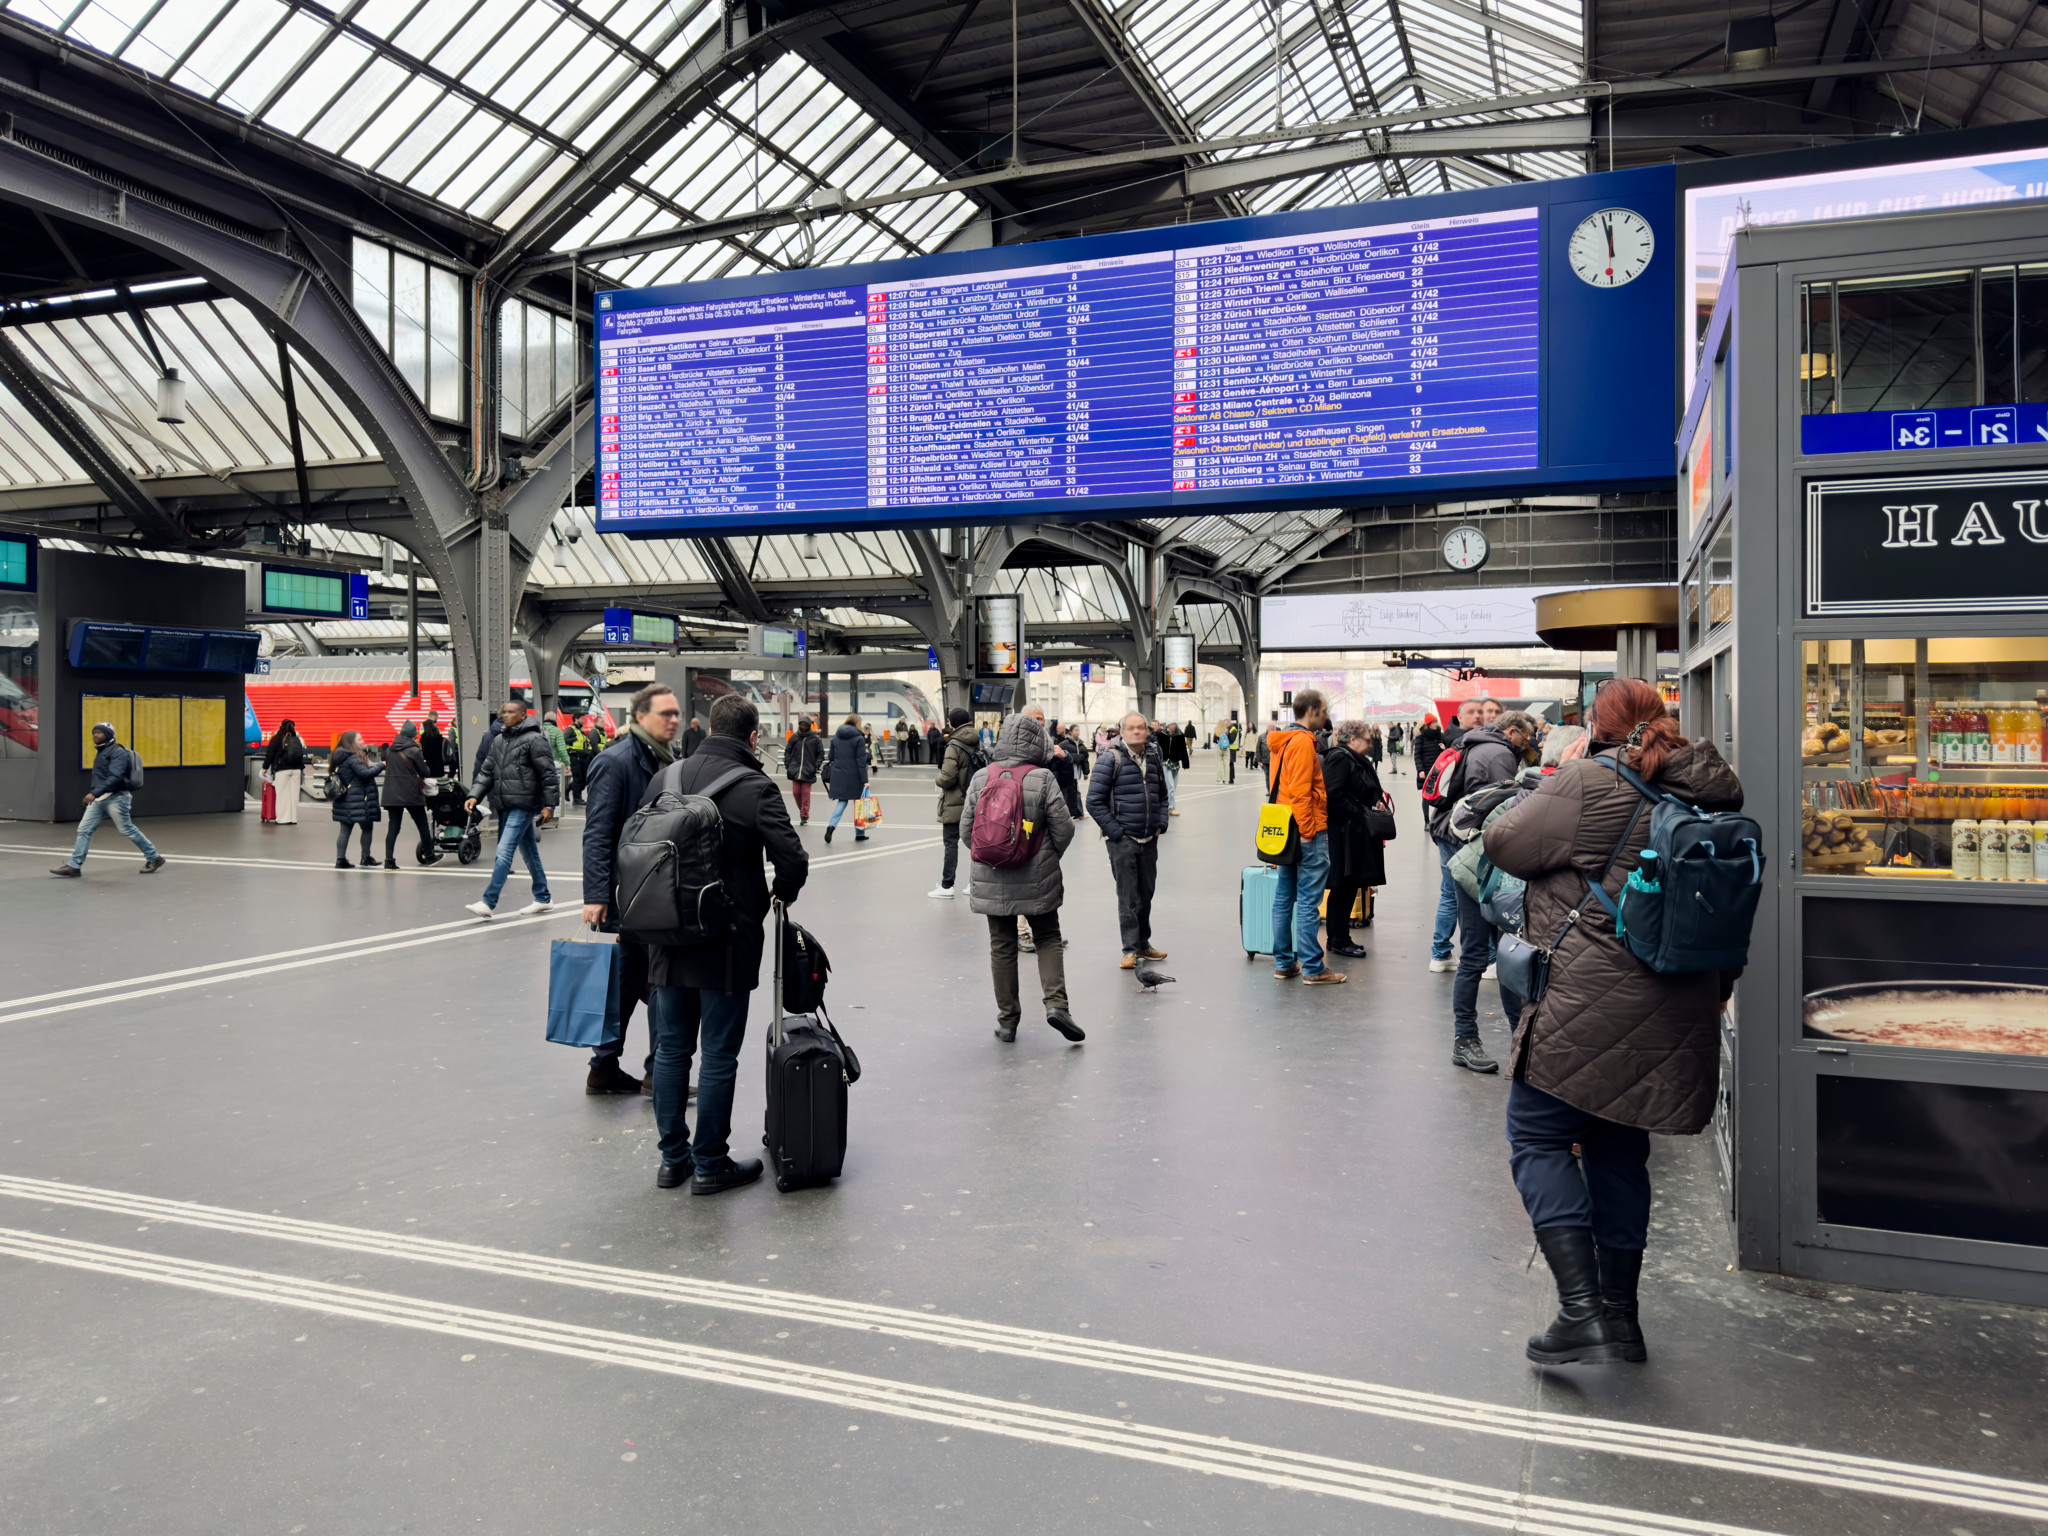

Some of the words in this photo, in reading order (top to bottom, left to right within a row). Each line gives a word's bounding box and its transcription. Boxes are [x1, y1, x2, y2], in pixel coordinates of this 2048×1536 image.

[1449, 216, 1478, 225] Hinweis
[1176, 259, 1190, 268] S24
[1200, 256, 1221, 265] 12:21
[1224, 254, 1241, 262] Zug
[1257, 248, 1293, 258] Wiedikon
[1298, 246, 1319, 254] Enge
[1323, 239, 1370, 251] Wollishofen
[1417, 232, 1423, 240] 3
[888, 291, 907, 299] 12:07
[940, 286, 968, 294] Sargans
[972, 281, 1007, 291] Landquart
[616, 310, 662, 319] Vorinformation
[664, 305, 704, 315] Bauarbeiten:
[706, 300, 759, 310] Fahrplanänderung:
[761, 297, 788, 305] Effretikon
[793, 293, 825, 302] Winterthur.
[616, 319, 635, 328] So/Mo
[714, 309, 731, 317] 05.35
[790, 301, 823, 310] Verbindung
[888, 322, 907, 330] 12:09
[936, 316, 976, 326] Hardbrücke
[979, 313, 1012, 322] Altstetten
[1016, 309, 1038, 318] Urdorf
[1066, 303, 1089, 313] 41/42
[1174, 315, 1185, 323] S3
[1199, 310, 1223, 321] 12:26
[1223, 308, 1252, 319] Zürich
[1254, 303, 1306, 316] Hardbrücke
[1411, 288, 1438, 299] 41/42
[616, 327, 642, 335] Fahrplan.
[1199, 345, 1221, 354] 12:30
[1223, 342, 1265, 352] Lausanne
[1282, 338, 1303, 346] Olten
[1308, 334, 1347, 344] Solothurn
[1351, 329, 1399, 340] Biel/Bienne
[1412, 325, 1422, 334] 18
[1198, 402, 1220, 411] 12:33
[1222, 401, 1252, 409] Milano
[1254, 396, 1292, 406] Centrale
[1308, 394, 1324, 402] Zug
[1329, 390, 1371, 400] Bellinzona
[1416, 384, 1422, 393] 9
[1173, 414, 1207, 422] Sektoren
[1208, 411, 1221, 419] AB
[1222, 410, 1254, 418] Chiasso
[1261, 406, 1297, 415] Sektoren
[1299, 403, 1312, 412] CD
[1314, 402, 1342, 411] Milano
[1198, 423, 1220, 432] 12:34
[1222, 421, 1246, 430] Basel
[1249, 420, 1268, 428] SBB
[1410, 407, 1421, 415] 12
[1173, 446, 1208, 455] Zwischen
[1211, 441, 1250, 452] Oberndorf
[1252, 440, 1285, 451] (Neckar)
[1287, 439, 1302, 447] und
[1305, 437, 1345, 446] Böblingen
[1348, 432, 1386, 444] (Flugfeld)
[1388, 430, 1429, 439] verkehren
[1432, 426, 1487, 436] Ersatzbusse.
[1197, 435, 1220, 445] 12:34
[1222, 433, 1262, 442] Stuttgart
[1264, 431, 1280, 439] Hbf
[1296, 427, 1350, 437] Schaffhausen
[1355, 424, 1384, 433] Singen
[1410, 419, 1421, 428] 17
[1197, 478, 1219, 487] 12:35
[1222, 477, 1262, 486] Konstanz
[1278, 473, 1303, 482] Zürich
[1320, 470, 1363, 479] Winterthur
[1409, 465, 1420, 473] 33
[355, 606, 364, 616] 11
[608, 632, 616, 640] 12
[622, 633, 629, 641] 12
[259, 664, 268, 672] 13
[1262, 826, 1285, 838] PETZL
